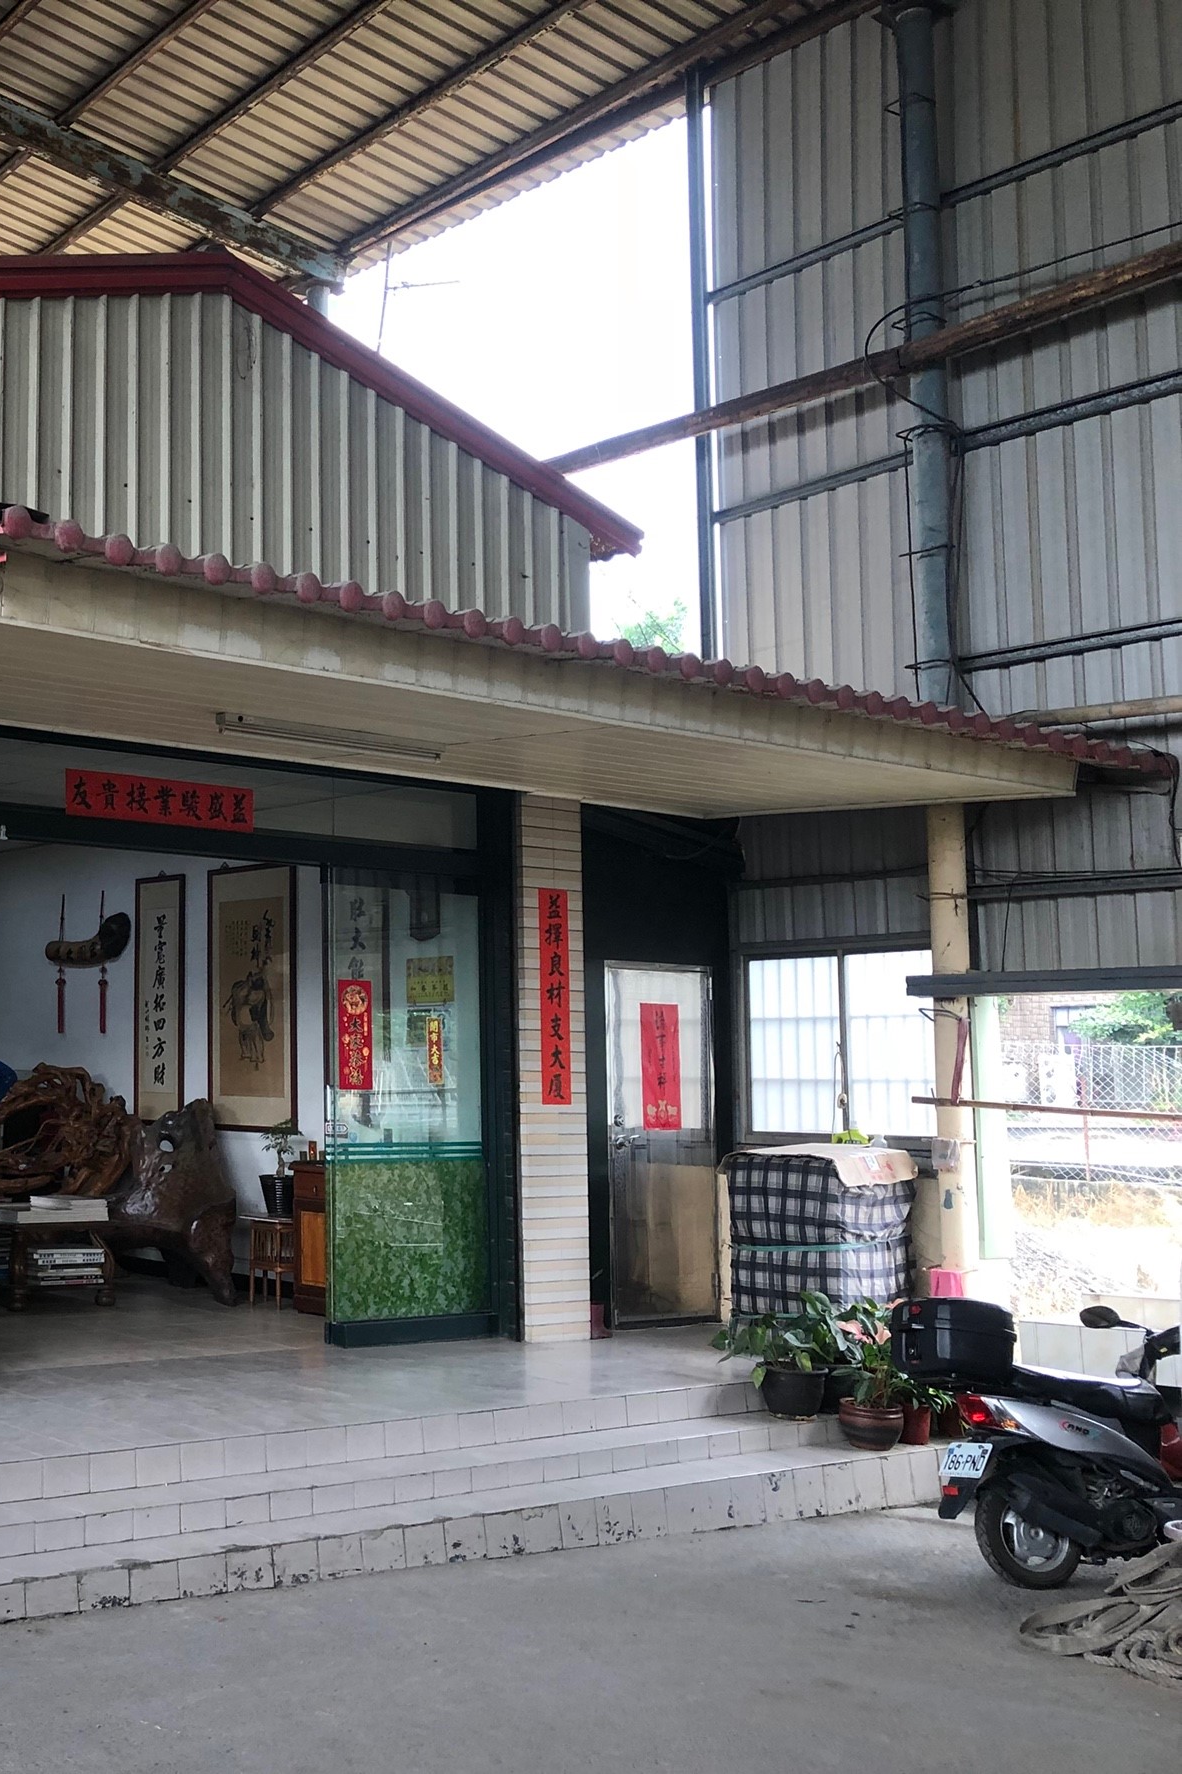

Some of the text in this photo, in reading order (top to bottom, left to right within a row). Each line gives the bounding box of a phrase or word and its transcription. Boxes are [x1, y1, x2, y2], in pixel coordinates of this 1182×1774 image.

[545, 895, 566, 1100] 益擇良材支大廈
[943, 1454, 986, 1472] 186-PND
